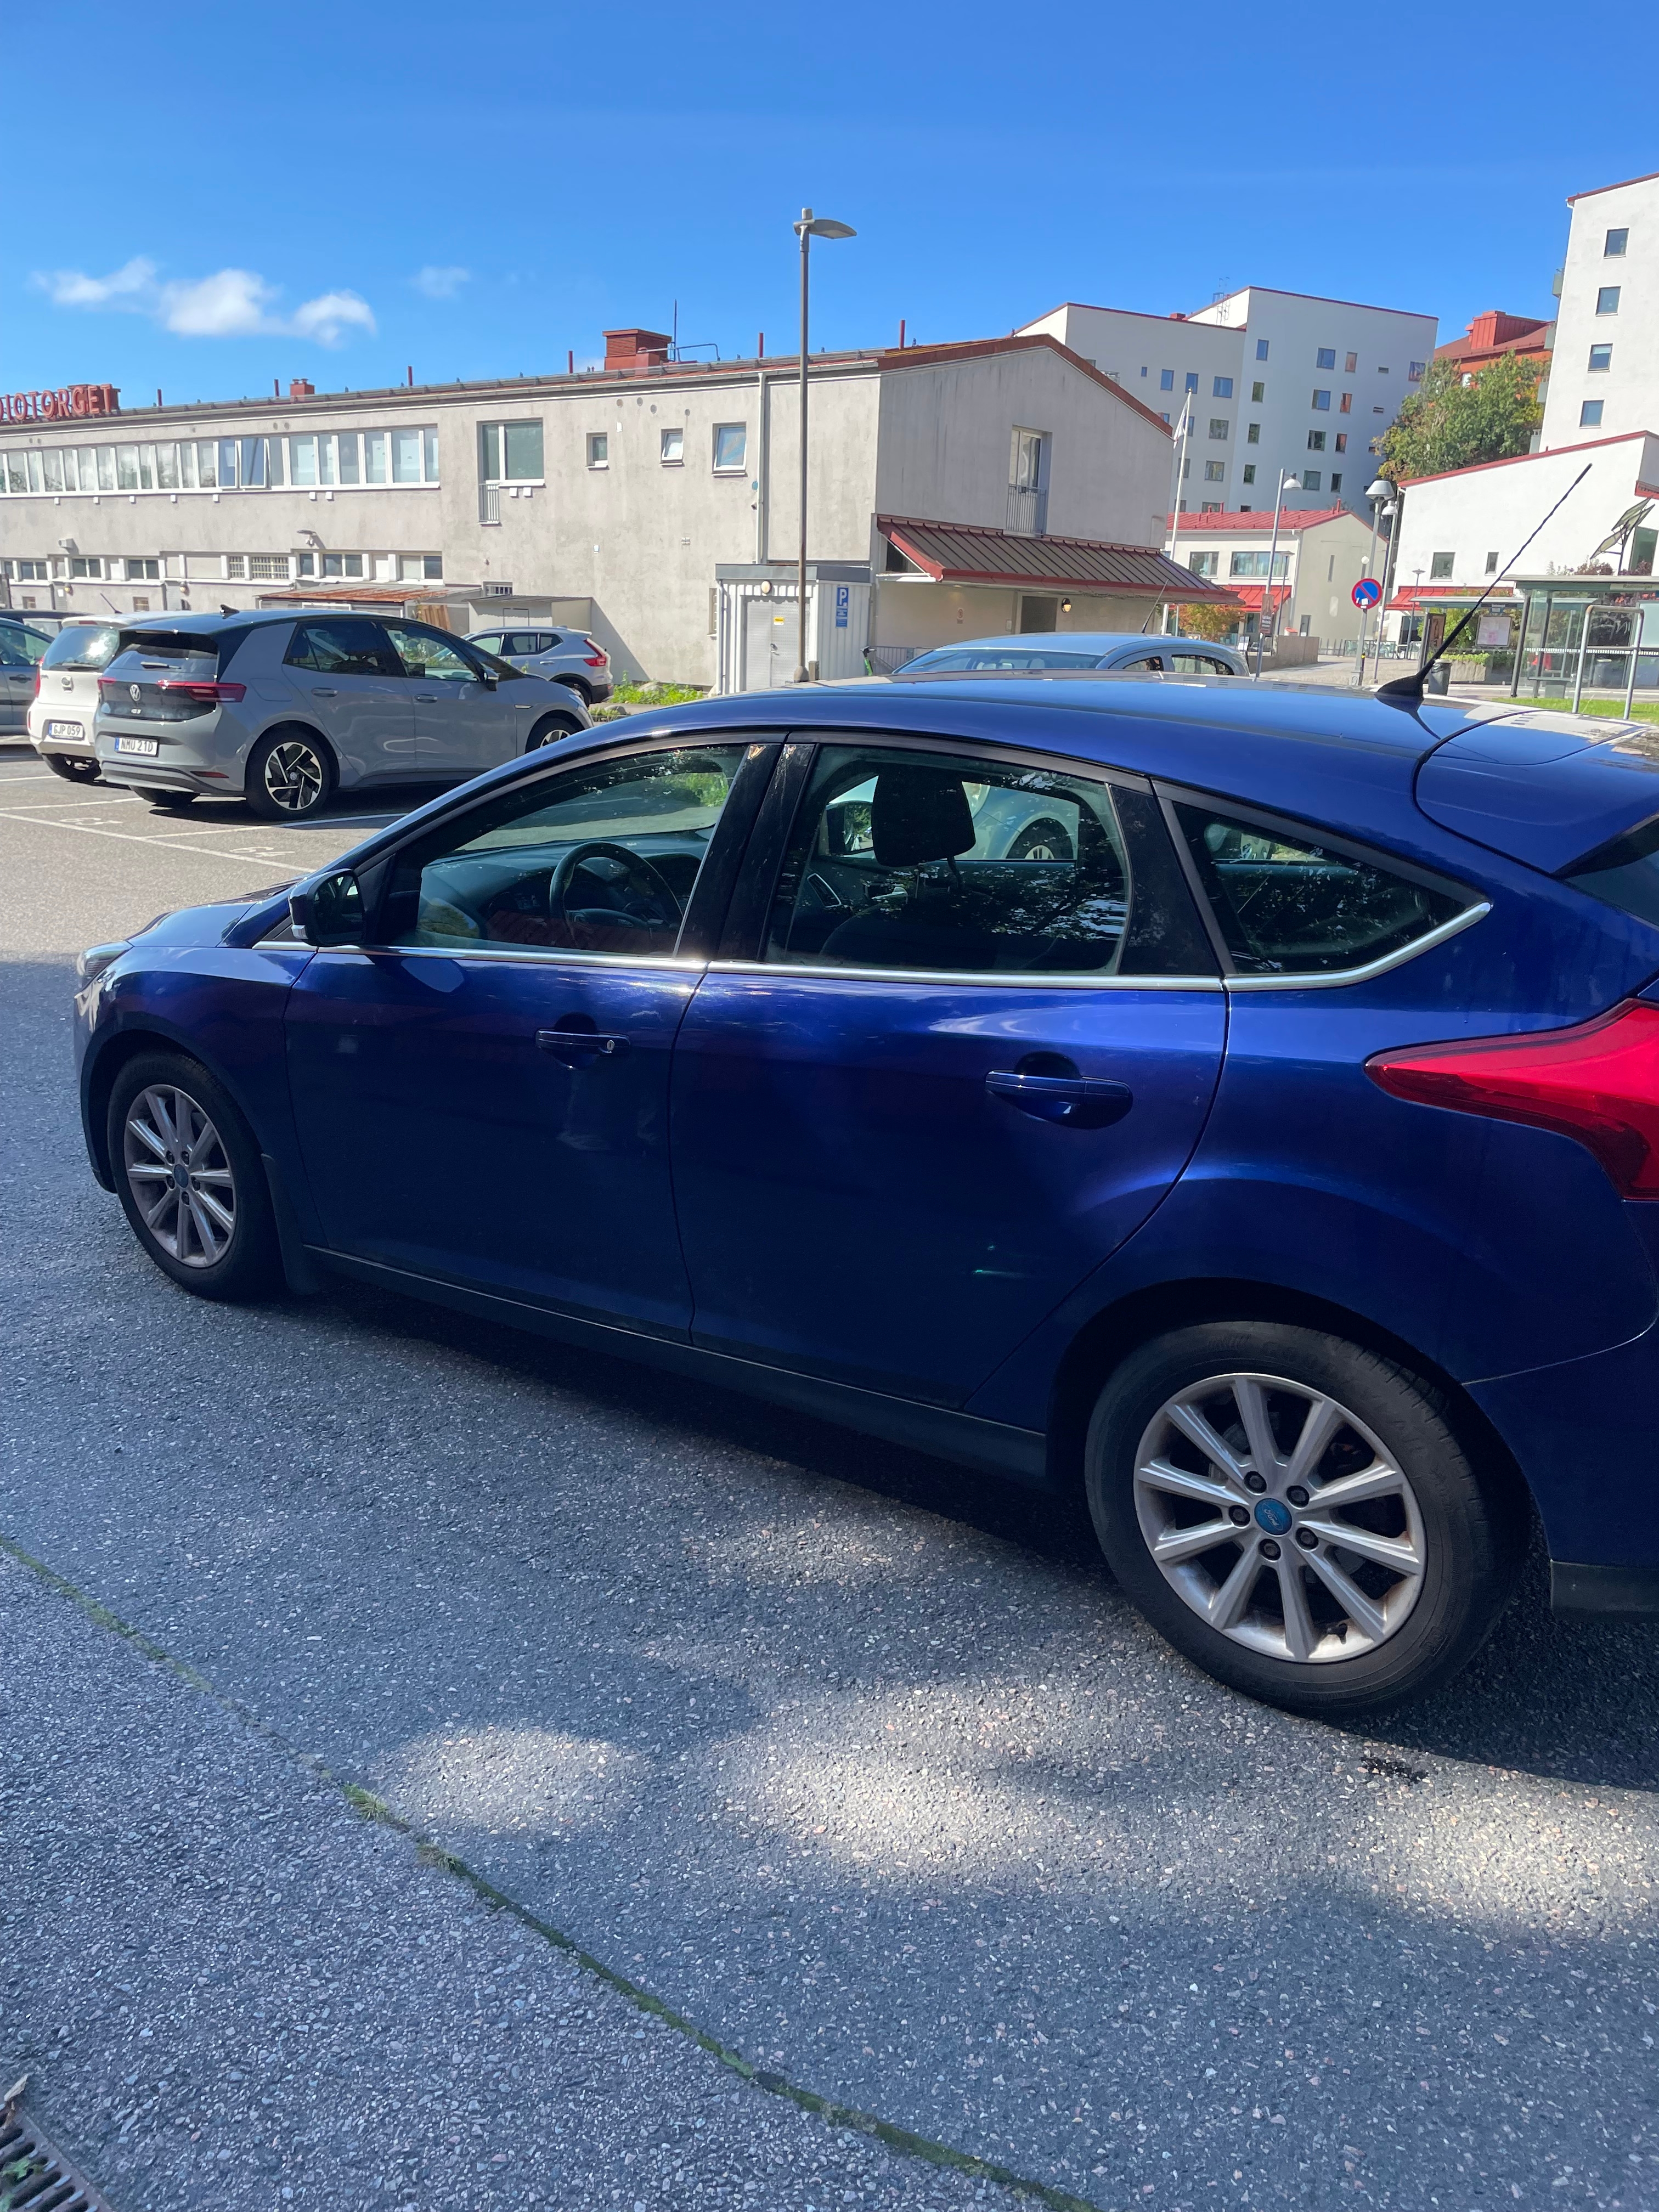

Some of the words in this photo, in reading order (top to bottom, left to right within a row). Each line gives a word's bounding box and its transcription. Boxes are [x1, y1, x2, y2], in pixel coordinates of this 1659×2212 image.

[0, 383, 112, 421] IOTORGET
[839, 589, 847, 605] P
[54, 724, 66, 734] GJP
[67, 725, 81, 736] 059
[137, 740, 153, 752] 21D
